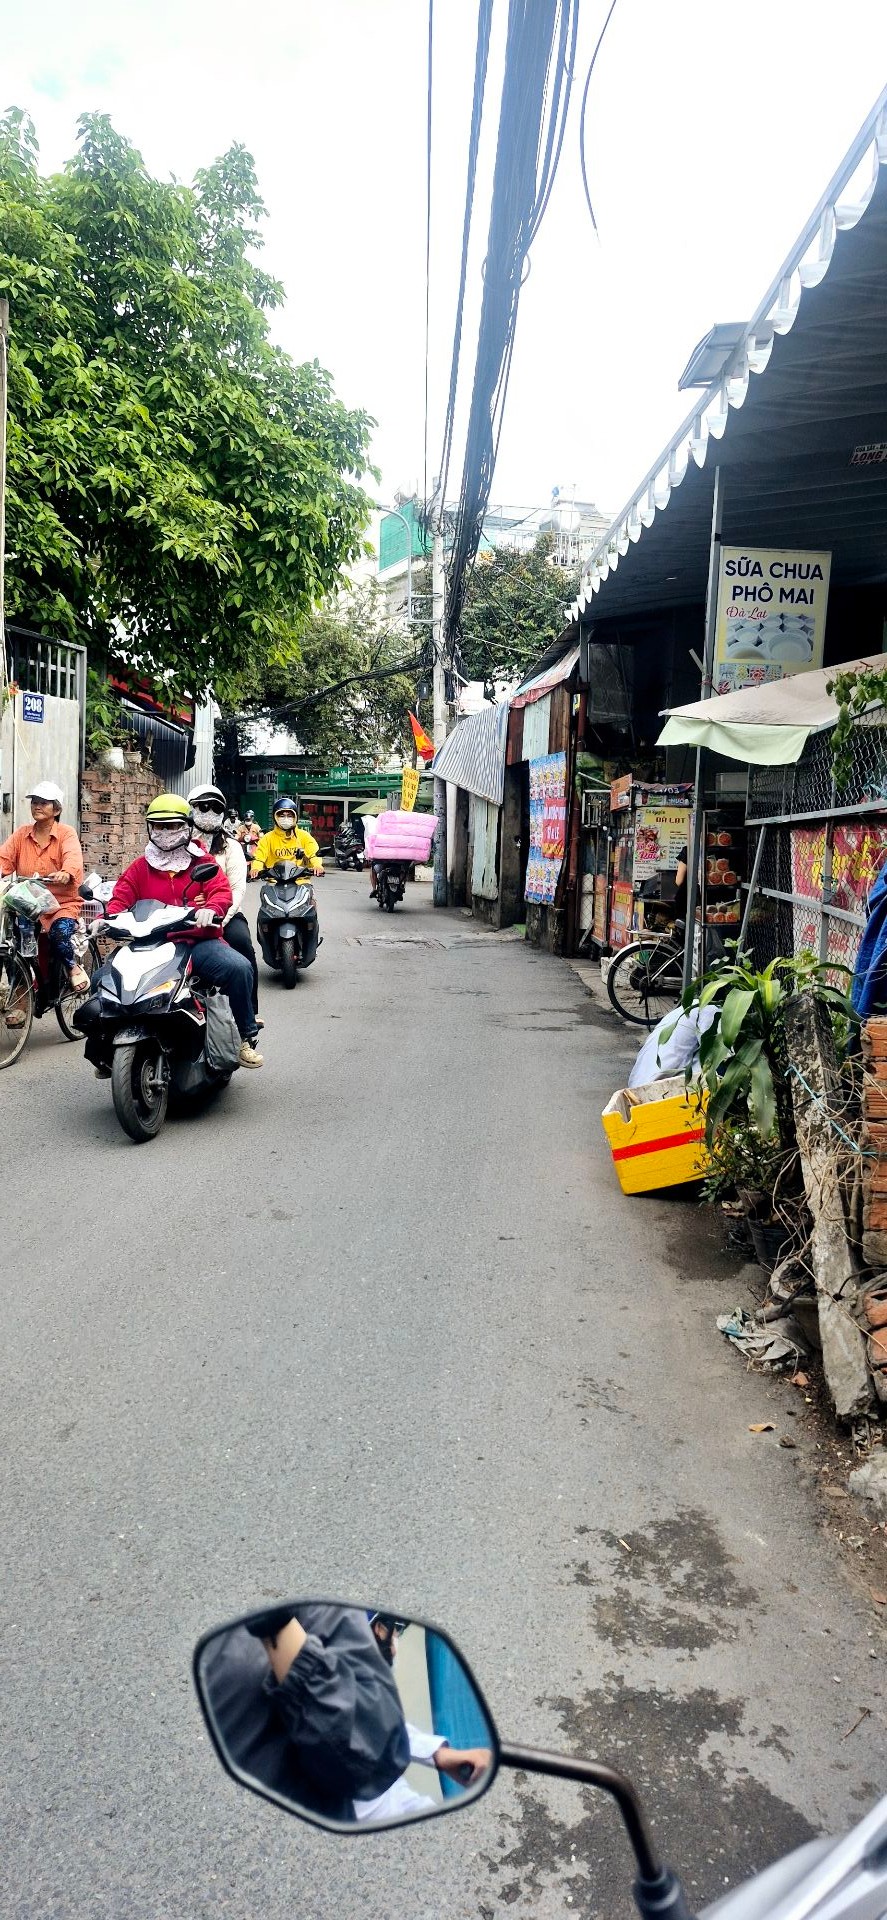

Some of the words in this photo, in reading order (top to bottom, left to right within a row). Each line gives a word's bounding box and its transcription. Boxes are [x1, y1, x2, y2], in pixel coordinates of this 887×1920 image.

[853, 451, 882, 462] LONG
[725, 556, 763, 577] SỮA
[769, 562, 824, 581] CHUA
[732, 582, 773, 603] PHÔ
[779, 587, 814, 605] MAI
[726, 606, 746, 618] Đà
[748, 607, 768, 620] Lạt
[25, 696, 42, 713] 208
